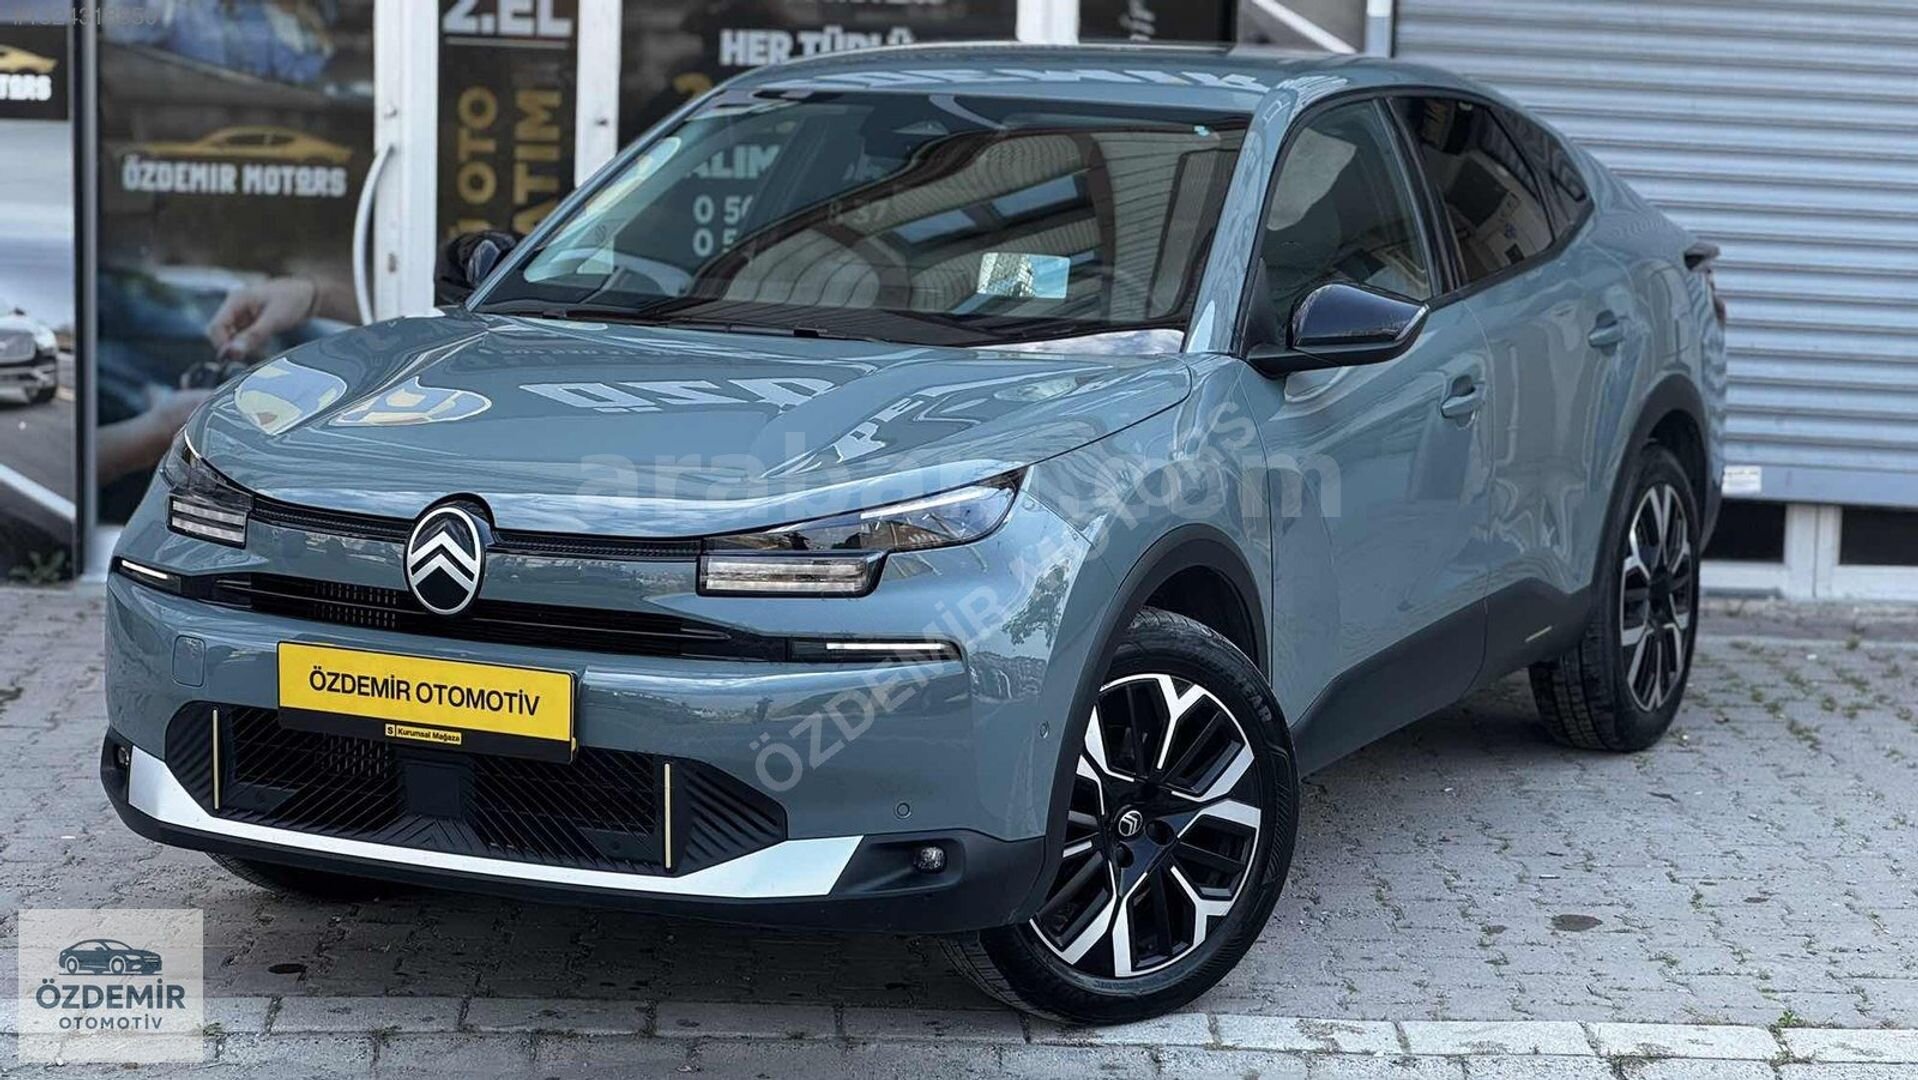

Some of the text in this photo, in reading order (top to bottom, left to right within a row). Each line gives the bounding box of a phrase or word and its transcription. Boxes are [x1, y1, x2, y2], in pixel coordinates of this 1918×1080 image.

[719, 28, 793, 66] HER
[457, 85, 498, 205] OTO
[241, 162, 348, 198] MOTORS
[692, 194, 714, 224] 0
[692, 228, 714, 257] 0
[309, 665, 540, 716] ÖZDEMİR OTOMOTİV
